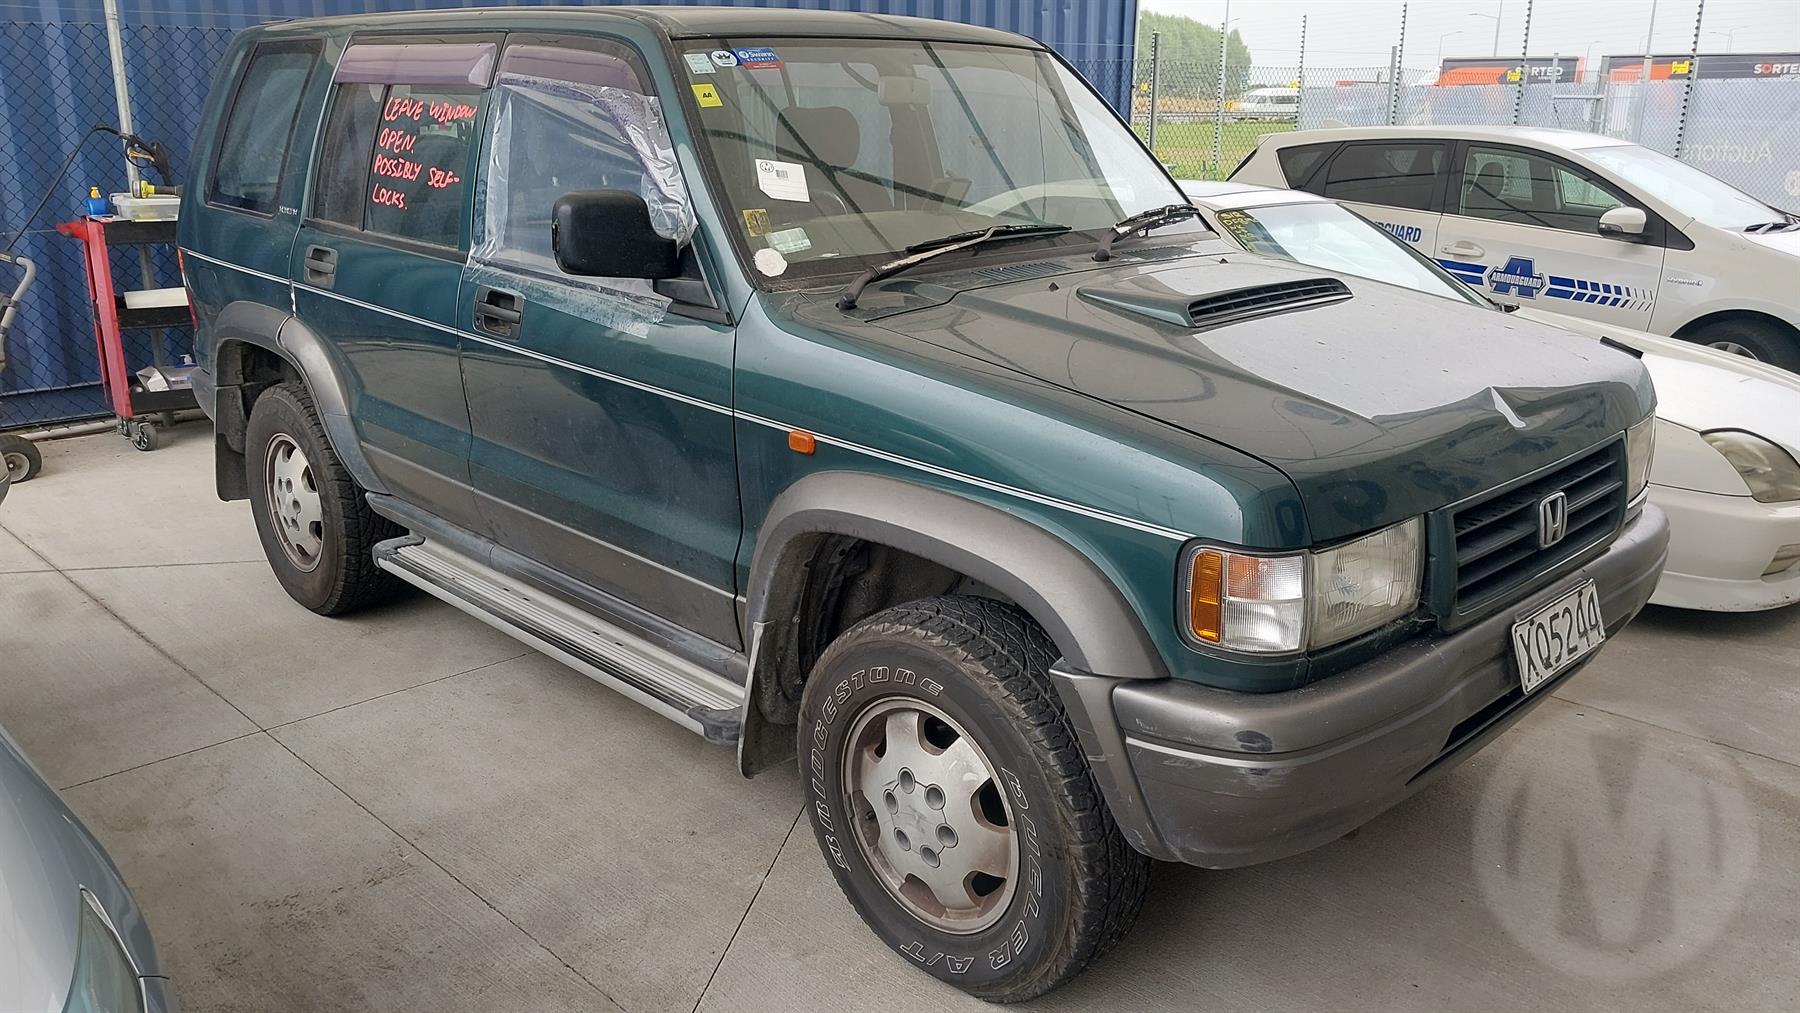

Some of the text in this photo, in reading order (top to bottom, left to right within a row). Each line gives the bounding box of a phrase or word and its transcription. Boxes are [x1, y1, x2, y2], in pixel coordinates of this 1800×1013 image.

[1753, 63, 1800, 75] SORTE
[384, 96, 478, 123] LEAVE WINDOW
[379, 127, 417, 154] OPEN.
[1491, 271, 1543, 289] ARMOURGUARD
[1519, 589, 1601, 684] XQ5244
[900, 767, 1042, 974] DUELER A/T
